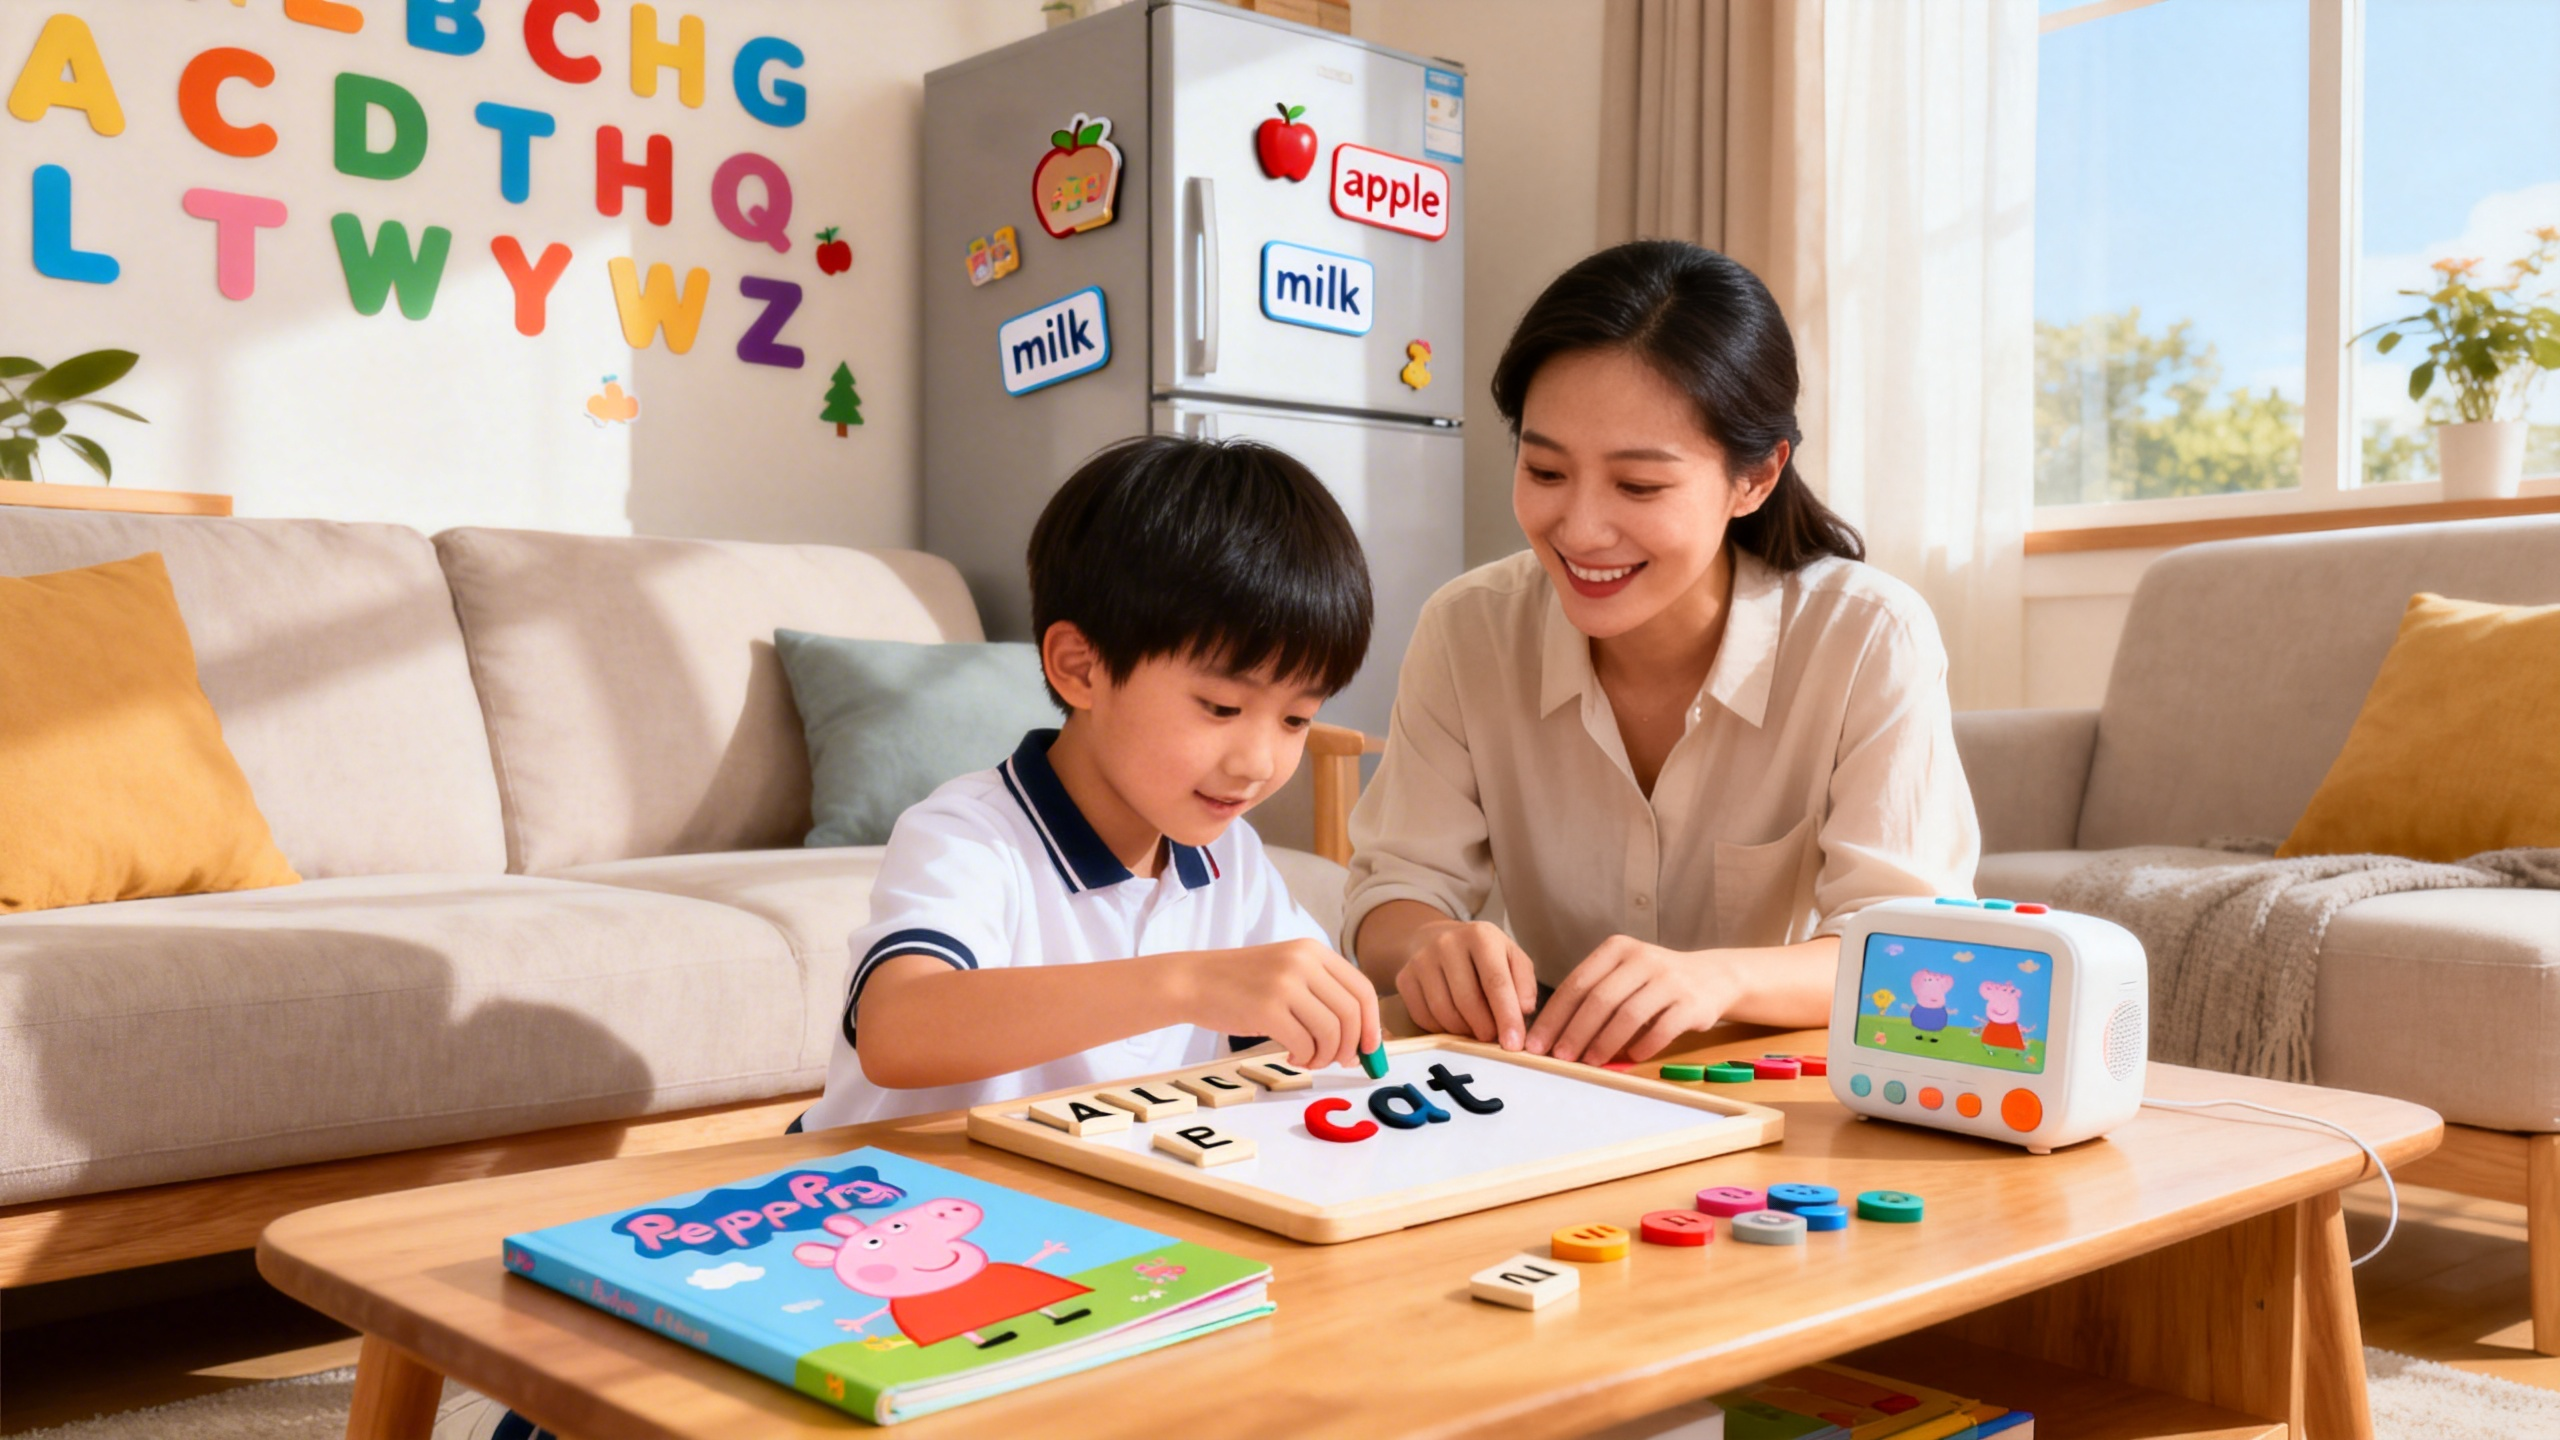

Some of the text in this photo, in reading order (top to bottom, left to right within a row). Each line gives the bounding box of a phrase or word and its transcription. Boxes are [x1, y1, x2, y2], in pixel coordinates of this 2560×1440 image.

[523, 0, 603, 85] C
[630, 2, 706, 109] H
[733, 36, 807, 128] G
[7, 13, 793, 254] A C D T H Q
[1342, 167, 1441, 219] apple
[32, 164, 805, 369] L T W Y W Z
[1276, 265, 1361, 315] milk
[1012, 309, 1095, 374] milk
[1304, 1063, 1504, 1143] cat
